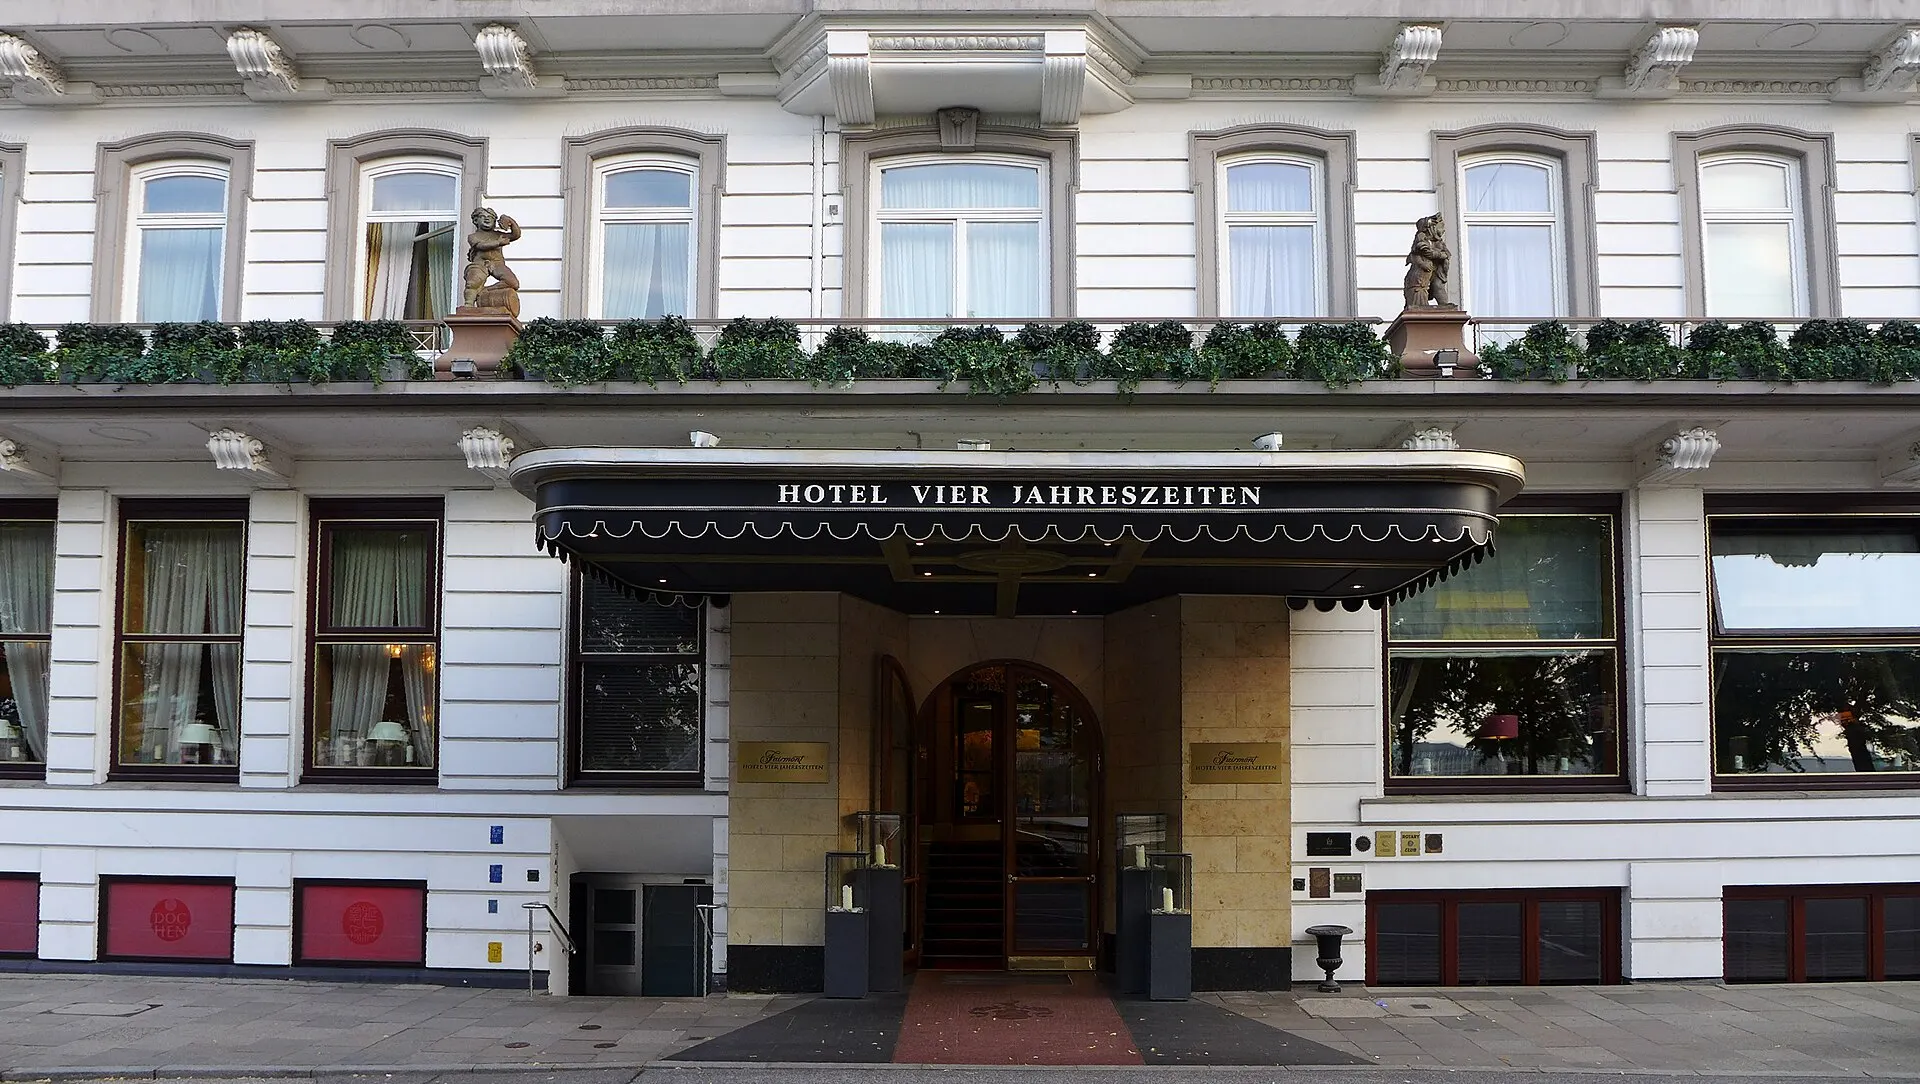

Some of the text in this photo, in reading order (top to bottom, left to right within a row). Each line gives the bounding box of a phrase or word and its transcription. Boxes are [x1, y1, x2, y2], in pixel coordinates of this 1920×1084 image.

[777, 484, 1261, 505] HOTEL VIER JAHRESZEITEN
[760, 750, 805, 764] Fairmont
[1213, 751, 1258, 765] Fairmont
[154, 912, 186, 924] DOC
